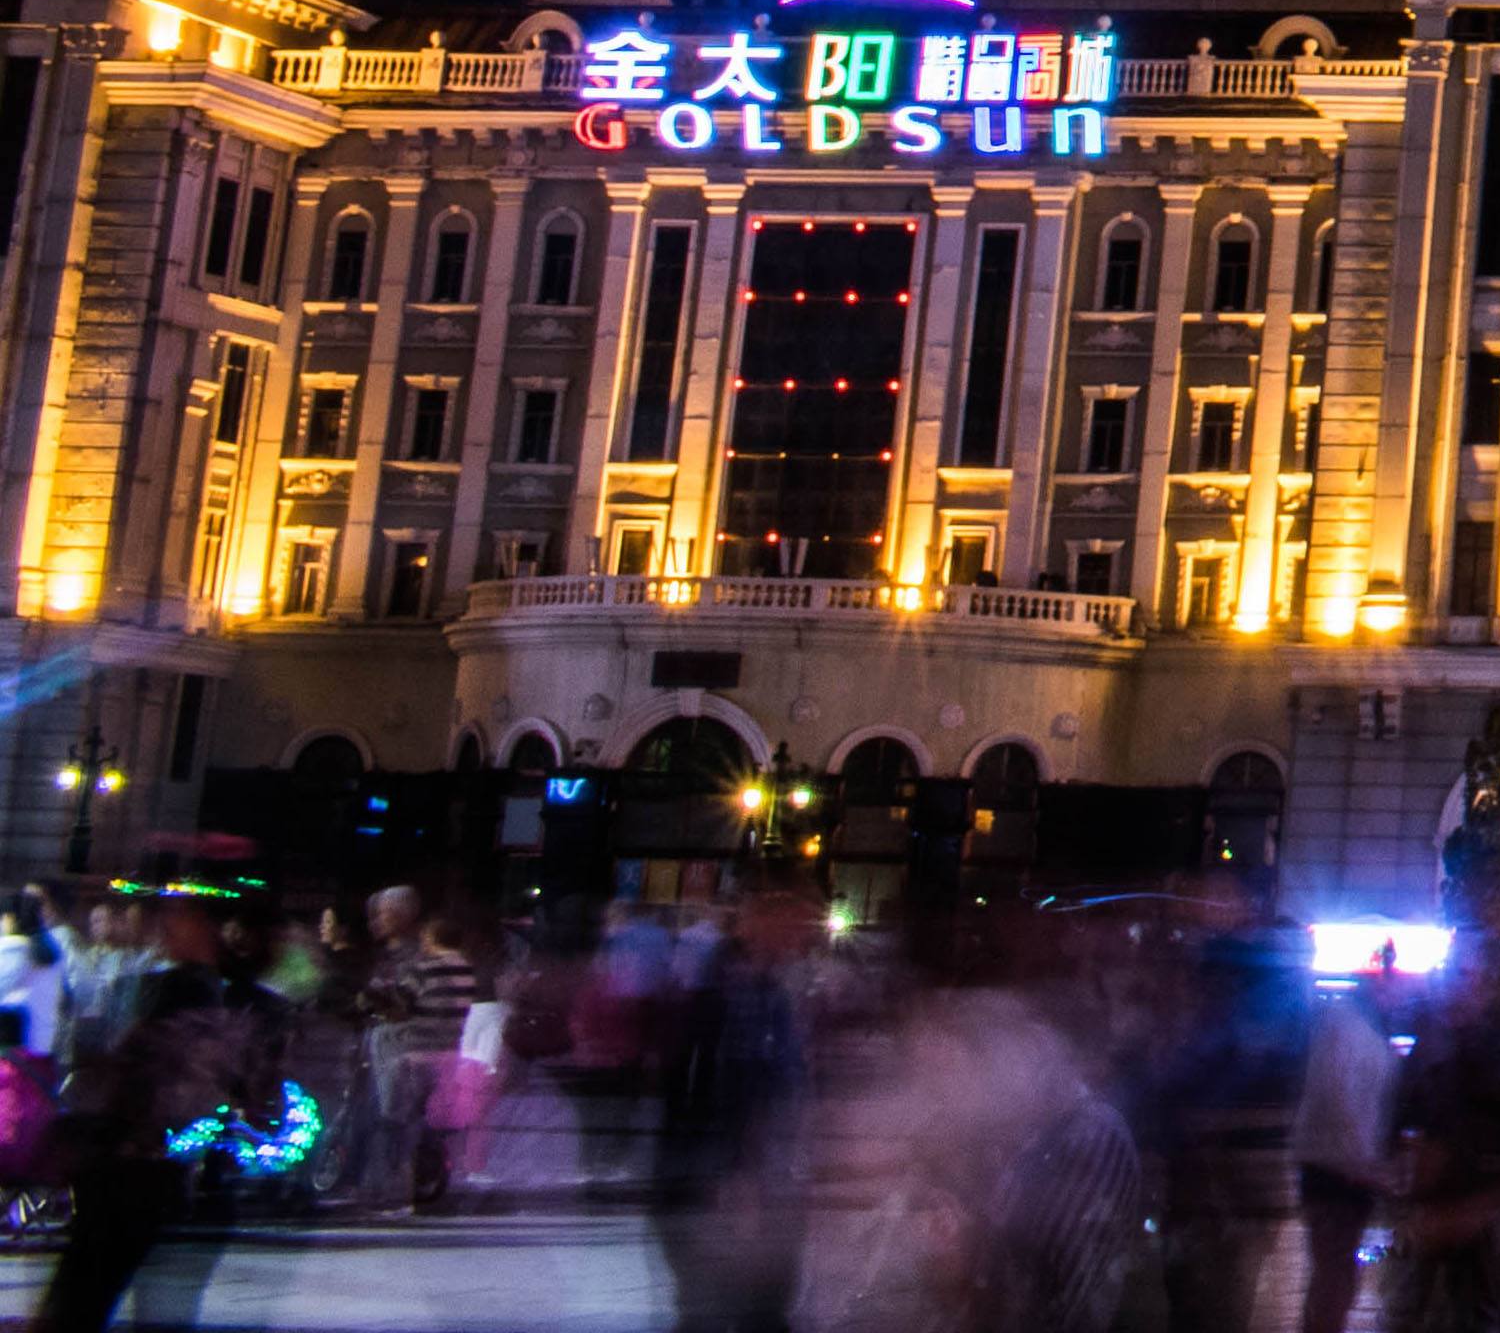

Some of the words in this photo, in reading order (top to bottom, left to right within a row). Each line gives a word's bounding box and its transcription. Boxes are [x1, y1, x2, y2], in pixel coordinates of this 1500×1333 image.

[581, 30, 1116, 102] 金太阳精品商城
